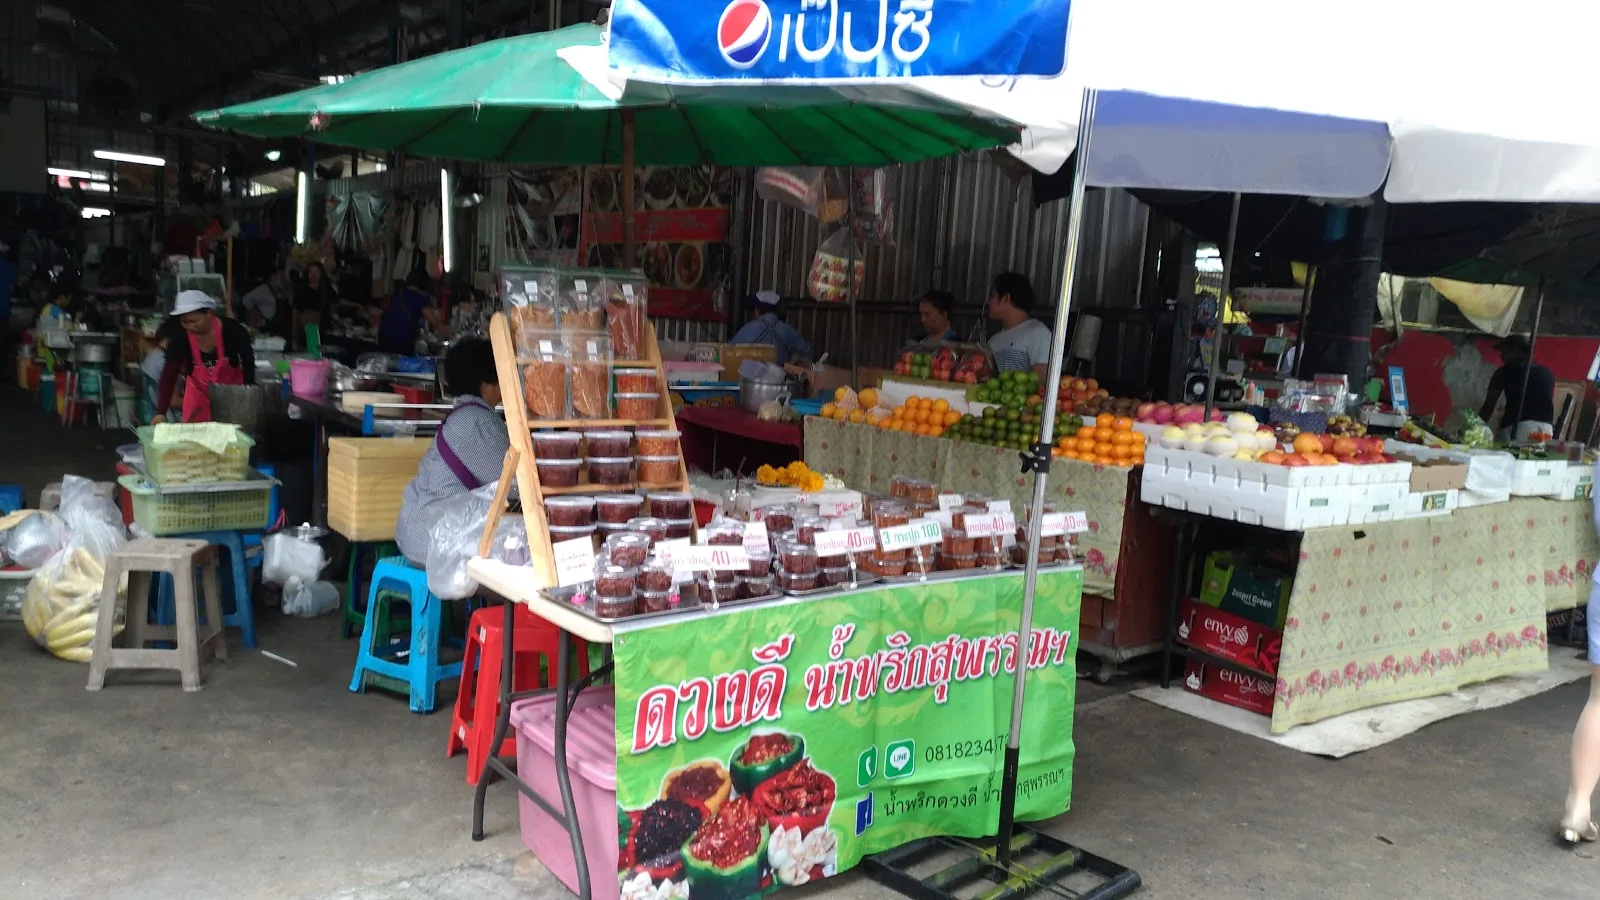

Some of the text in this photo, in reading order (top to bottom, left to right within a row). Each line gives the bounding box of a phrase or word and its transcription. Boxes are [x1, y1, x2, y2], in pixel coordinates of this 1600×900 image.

[992, 516, 1004, 531] 40
[1063, 515, 1075, 529] 40
[847, 531, 862, 548] 40
[883, 531, 890, 545] 3
[921, 523, 940, 538] 100
[711, 549, 730, 566] 40
[1204, 617, 1235, 644] envy
[1219, 668, 1258, 694] envy
[631, 634, 794, 754] ดวงดี
[893, 752, 908, 762] LINE
[884, 786, 978, 817] น้ำพริกดวงดี
